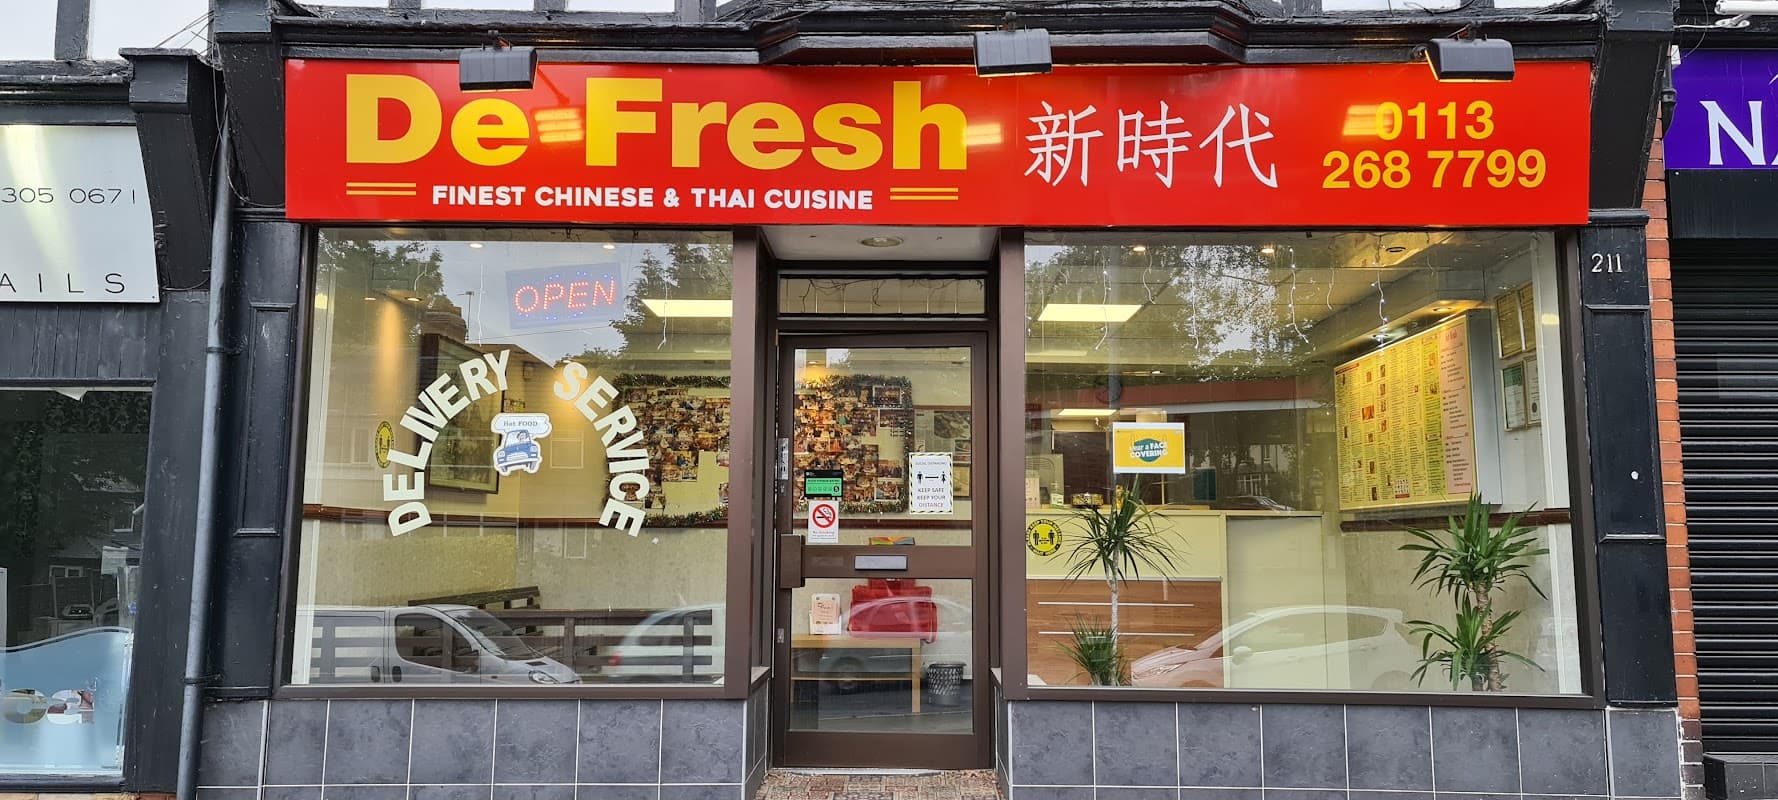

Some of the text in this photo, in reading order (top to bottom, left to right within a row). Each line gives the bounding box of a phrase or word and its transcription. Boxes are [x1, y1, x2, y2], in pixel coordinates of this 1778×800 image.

[346, 74, 967, 170] De Fresh
[1374, 101, 1495, 140] 0113
[1699, 100, 1778, 165] N
[1024, 100, 1279, 189] 新時代
[1322, 149, 1546, 189] 268 7799
[2, 187, 136, 204] 305 0671
[432, 185, 873, 210] FINEST CHINESE & THAI CUISINE
[1591, 253, 1623, 273] 211
[514, 279, 617, 313] OPEN
[383, 349, 651, 538] DELIVERY SERVICE
